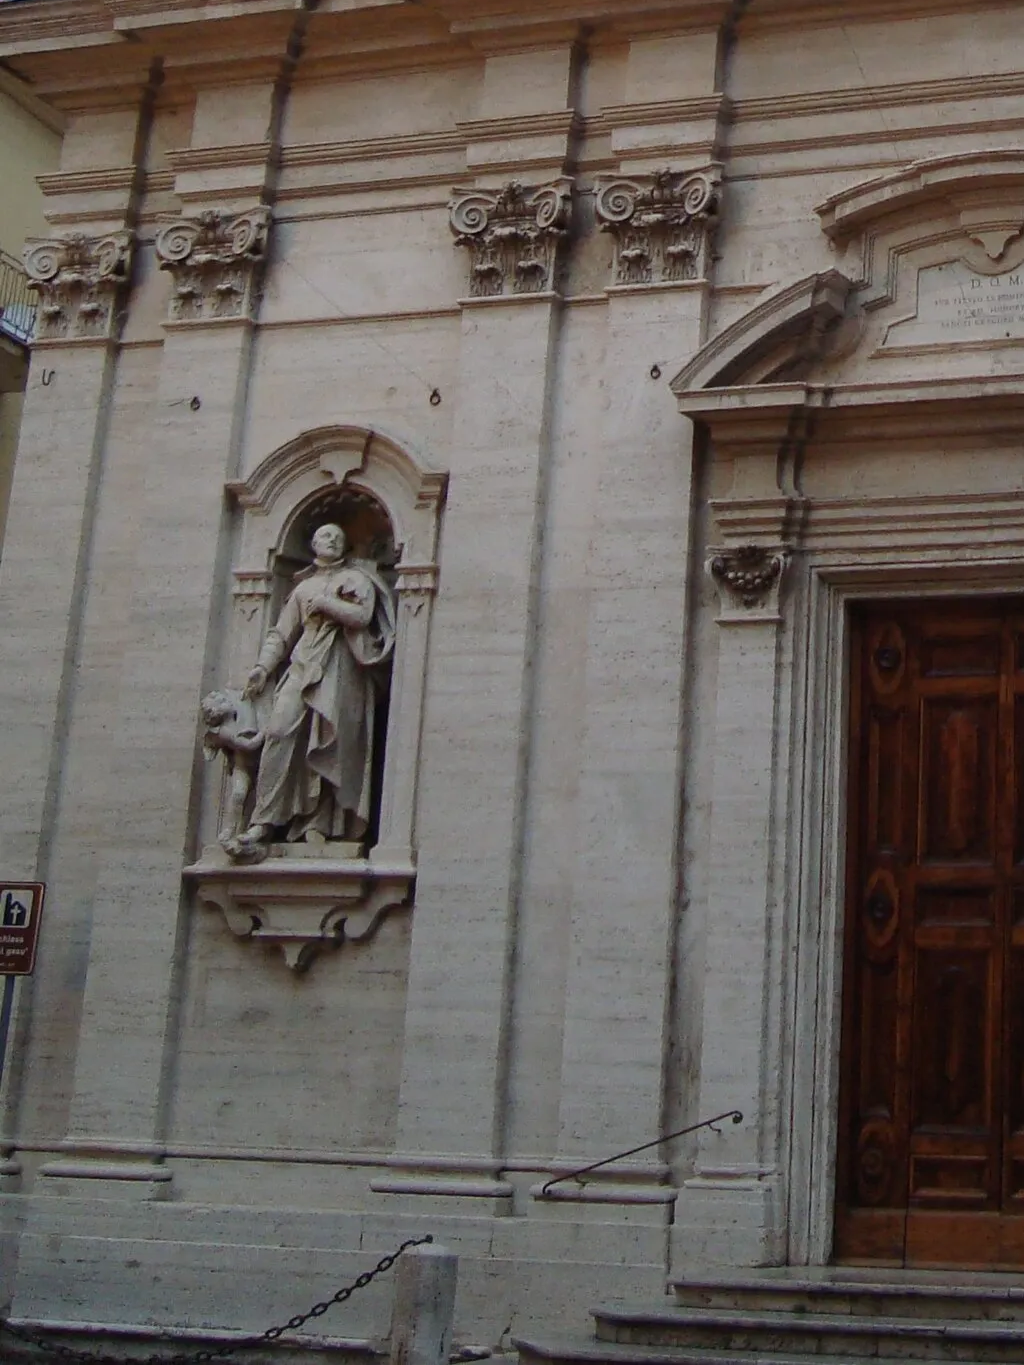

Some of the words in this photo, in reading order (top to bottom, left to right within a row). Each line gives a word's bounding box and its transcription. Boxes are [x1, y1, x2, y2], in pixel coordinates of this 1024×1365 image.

[970, 278, 983, 290] D.
[990, 277, 1001, 287] O.
[1009, 275, 1023, 287] M.
